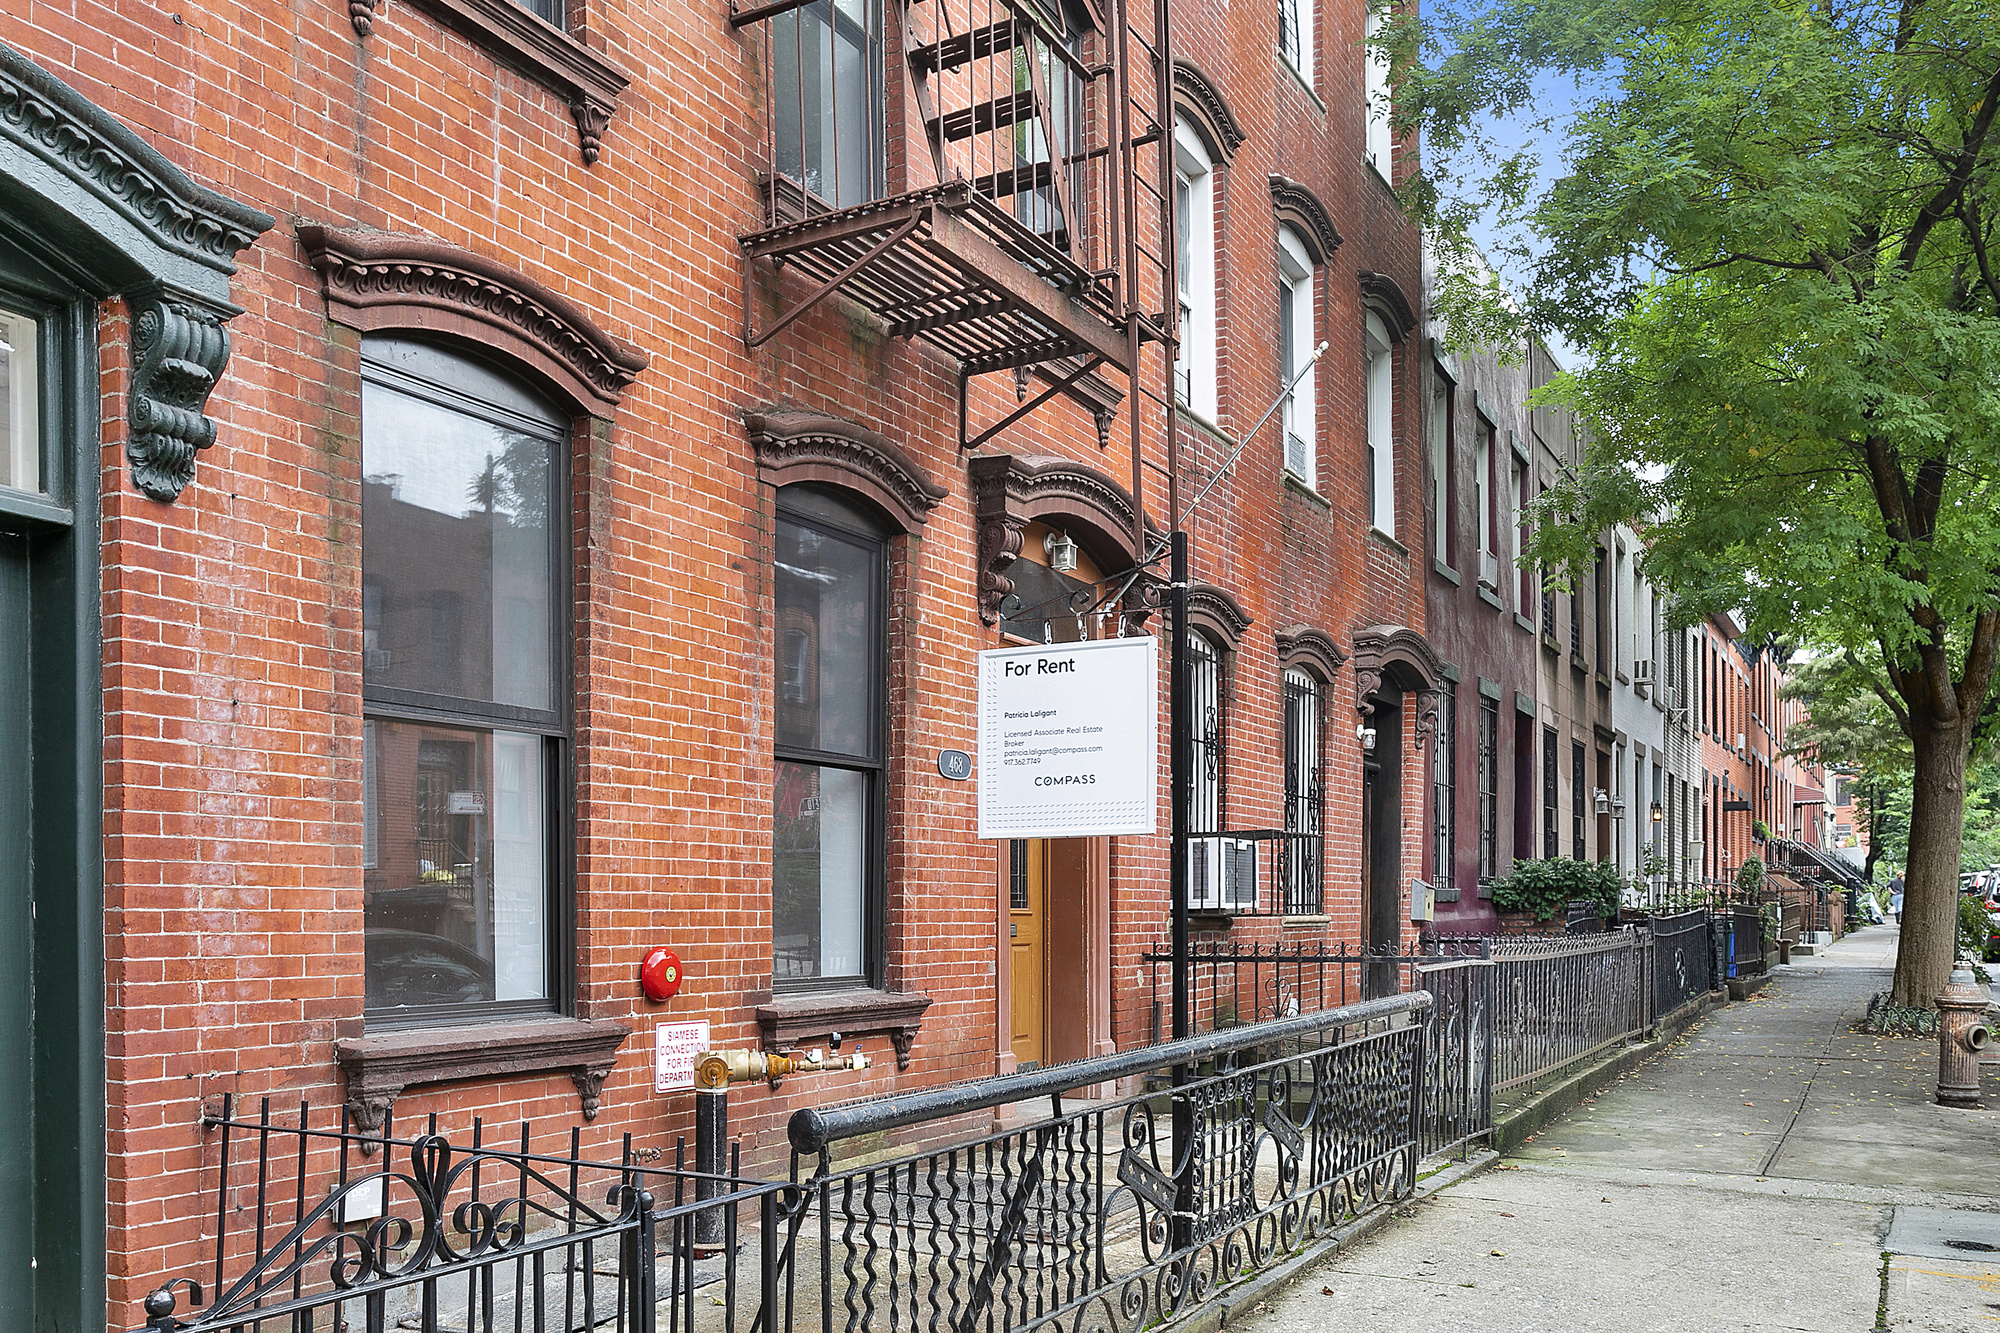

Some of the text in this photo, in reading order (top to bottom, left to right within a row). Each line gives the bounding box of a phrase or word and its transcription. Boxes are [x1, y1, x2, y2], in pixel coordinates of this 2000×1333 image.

[1005, 658, 1076, 677] For Rent
[1030, 710, 1057, 719] Laligant
[1004, 729, 1033, 738] Licensed
[1033, 728, 1065, 736] Associate
[1082, 725, 1104, 733] Estate
[1004, 740, 1025, 748] Broker
[1003, 745, 1104, 758] patricia.laligant@compass.com
[949, 755, 963, 774] 468
[1034, 774, 1096, 787] COMPASS
[668, 1029, 699, 1041] SIAMESE
[660, 1042, 706, 1056] CONNECTION
[667, 1056, 695, 1069] FOR FIR
[660, 1071, 694, 1084] DEPARTM
